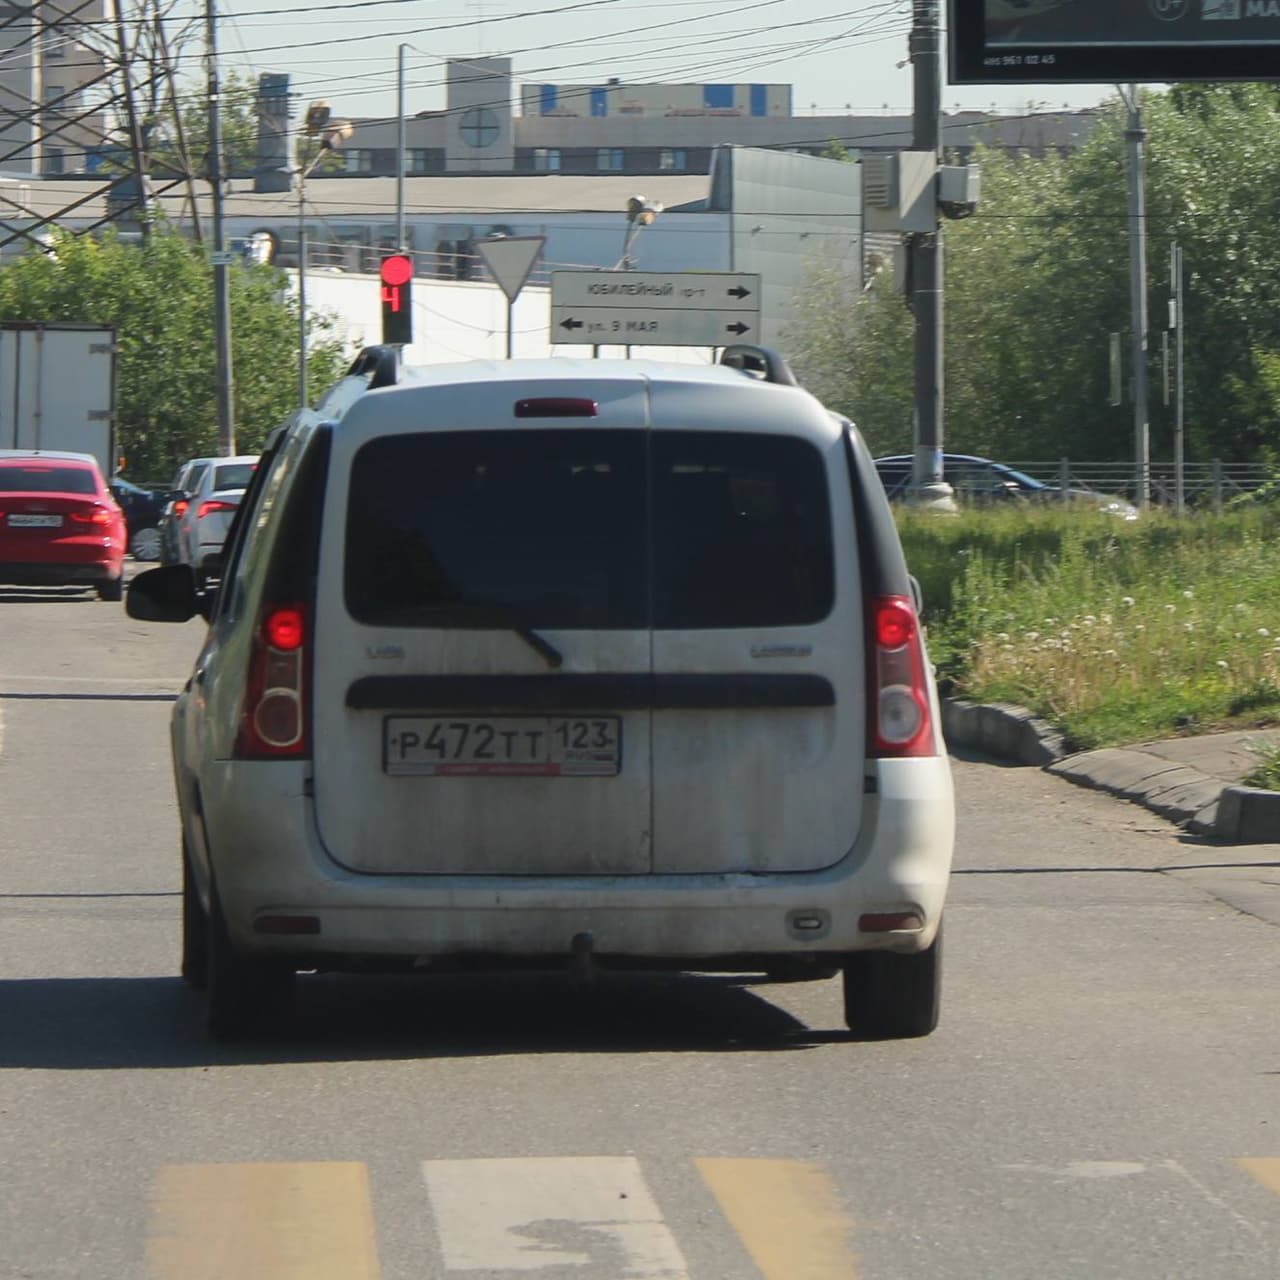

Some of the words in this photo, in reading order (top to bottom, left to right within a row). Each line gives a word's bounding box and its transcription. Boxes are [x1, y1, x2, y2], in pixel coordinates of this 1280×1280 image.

[587, 281, 672, 296] ЮБИЛЕЙНЫЙ
[612, 321, 620, 332] 9
[626, 321, 659, 332] МАЯ
